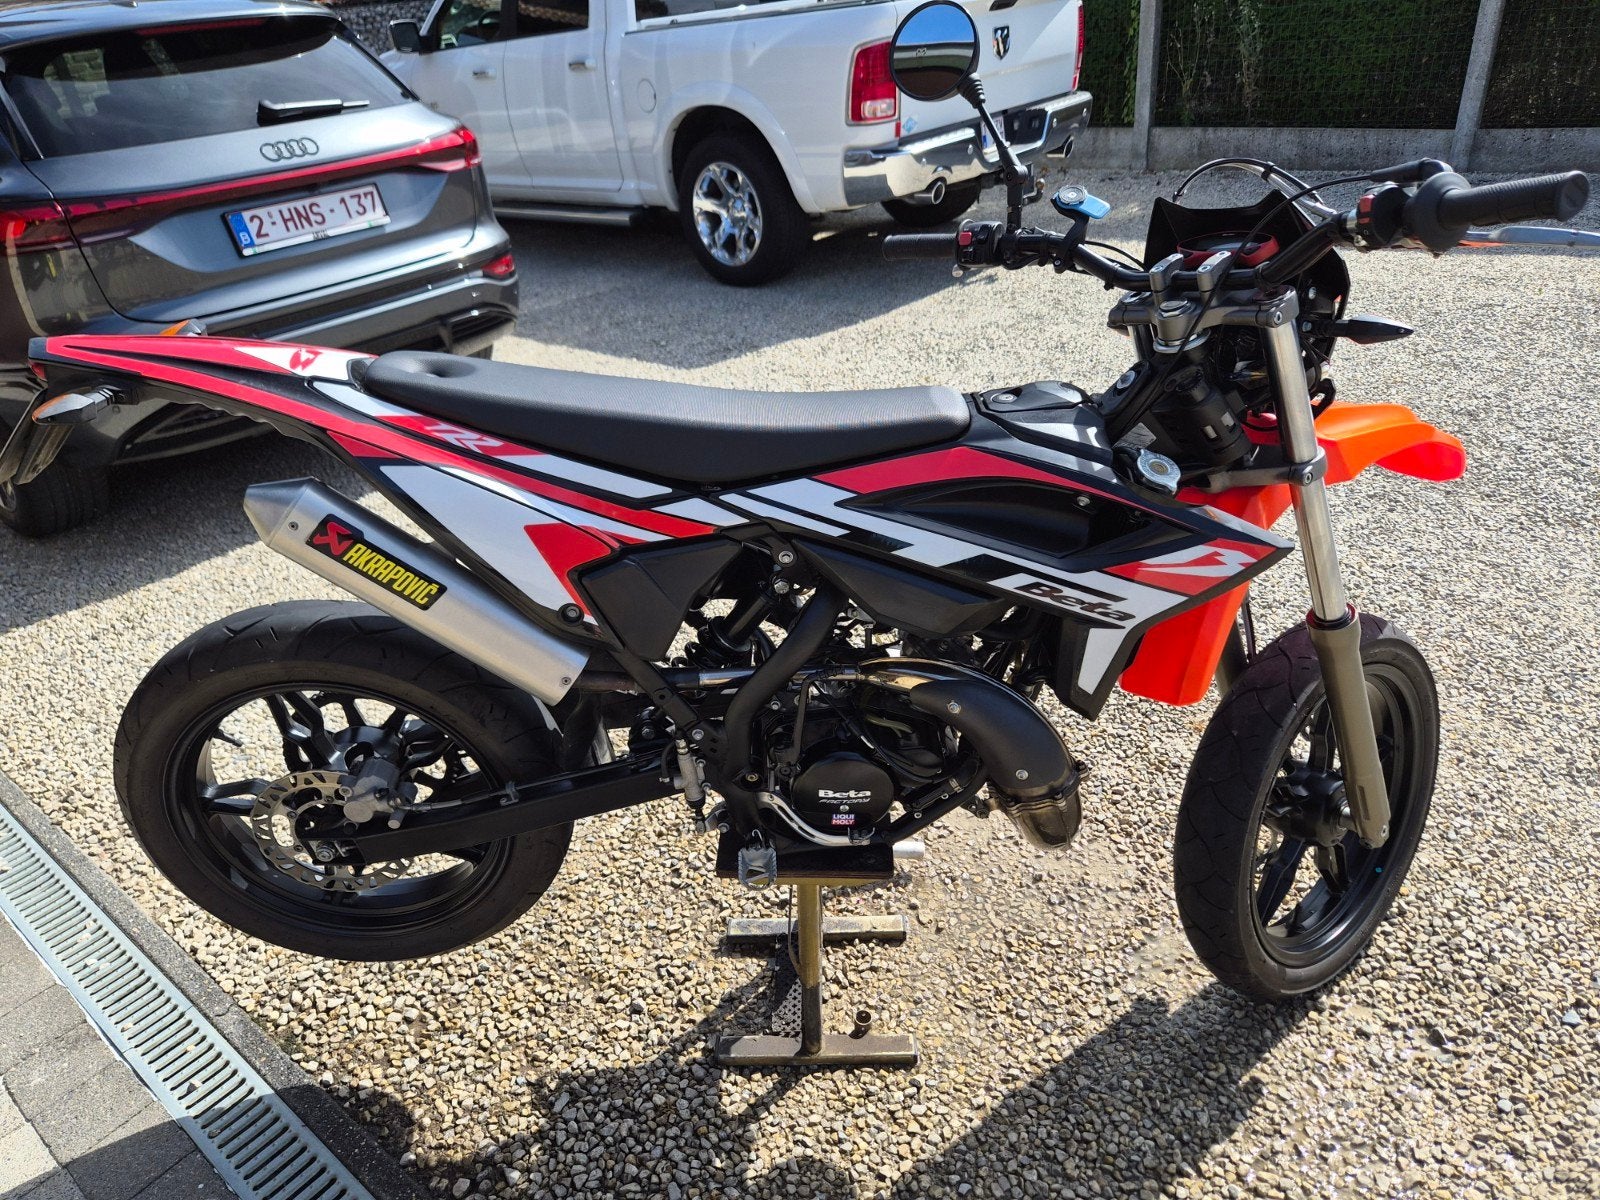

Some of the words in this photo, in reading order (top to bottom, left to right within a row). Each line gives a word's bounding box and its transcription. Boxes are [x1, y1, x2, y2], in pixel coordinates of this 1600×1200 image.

[342, 543, 439, 605] AKRAPOVIČ
[1013, 581, 1136, 622] Beta
[818, 789, 871, 798] Beta
